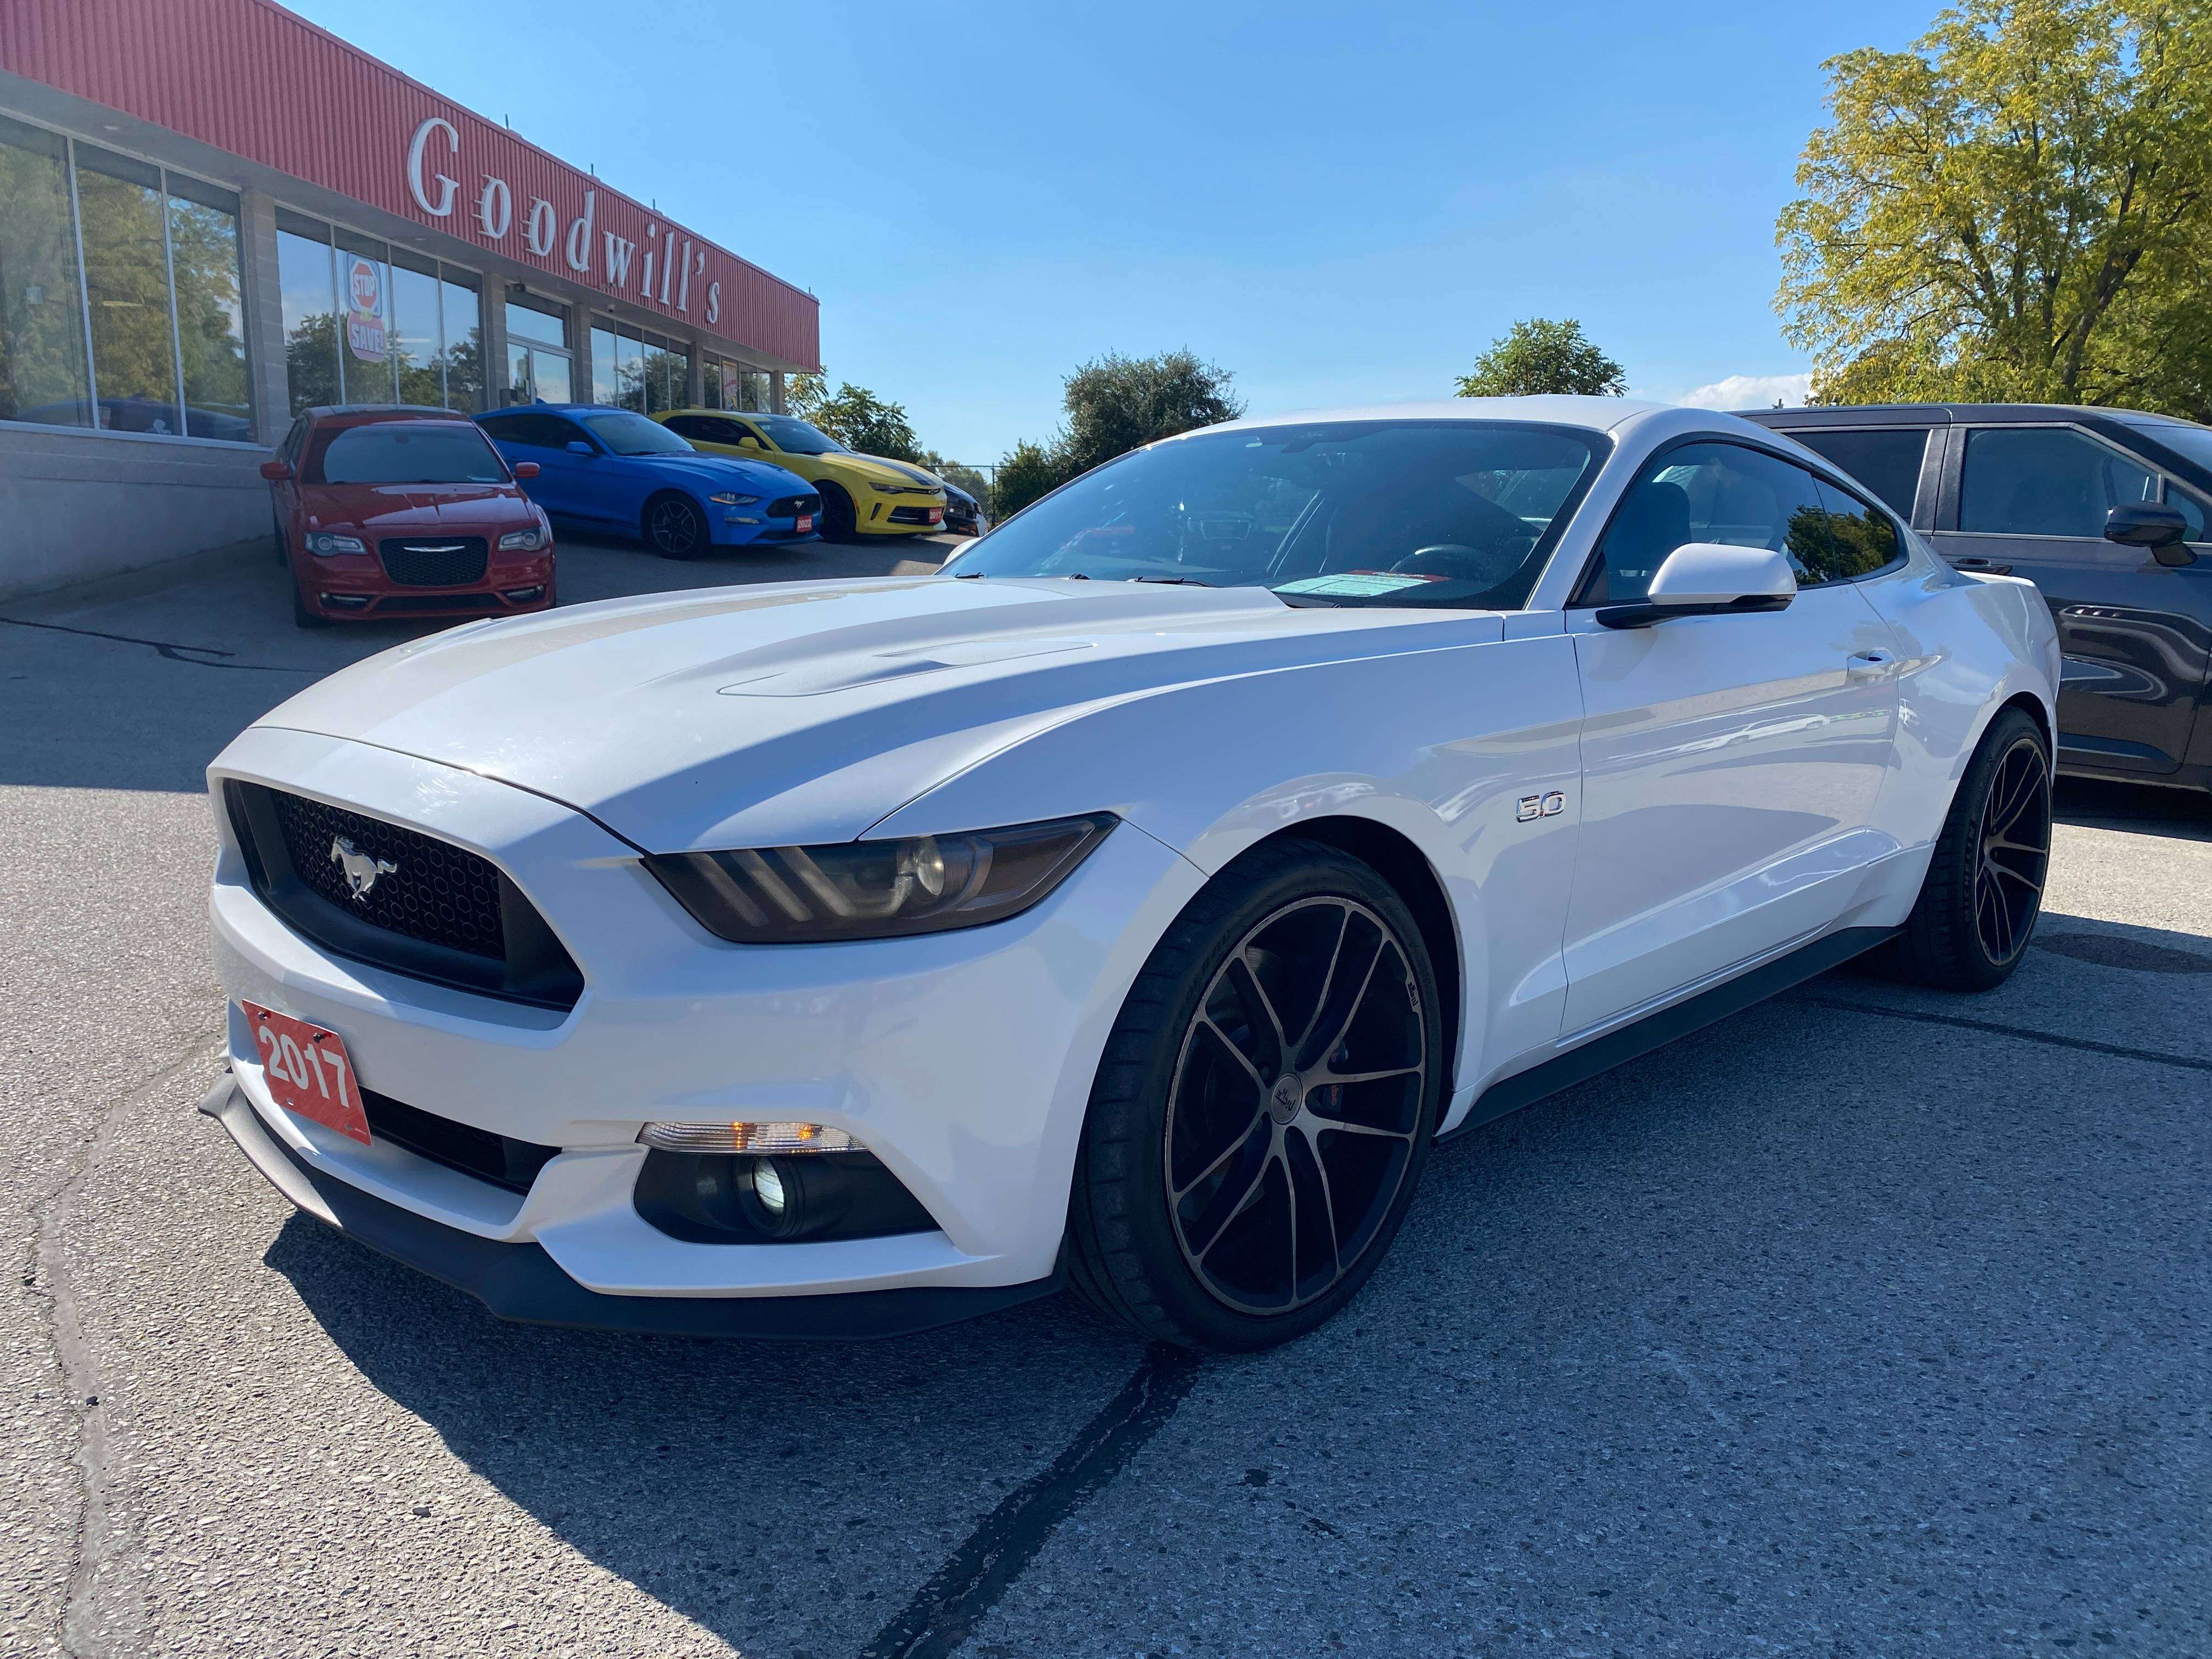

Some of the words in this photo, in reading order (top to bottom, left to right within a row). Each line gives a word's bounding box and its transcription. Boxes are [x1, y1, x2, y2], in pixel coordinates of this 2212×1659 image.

[408, 117, 719, 324] Goodwill's
[353, 274, 375, 297] STOP
[351, 323, 384, 354] SAVE!
[798, 519, 812, 528] 2022
[929, 511, 941, 520] 2017
[259, 1025, 349, 1108] 2017
